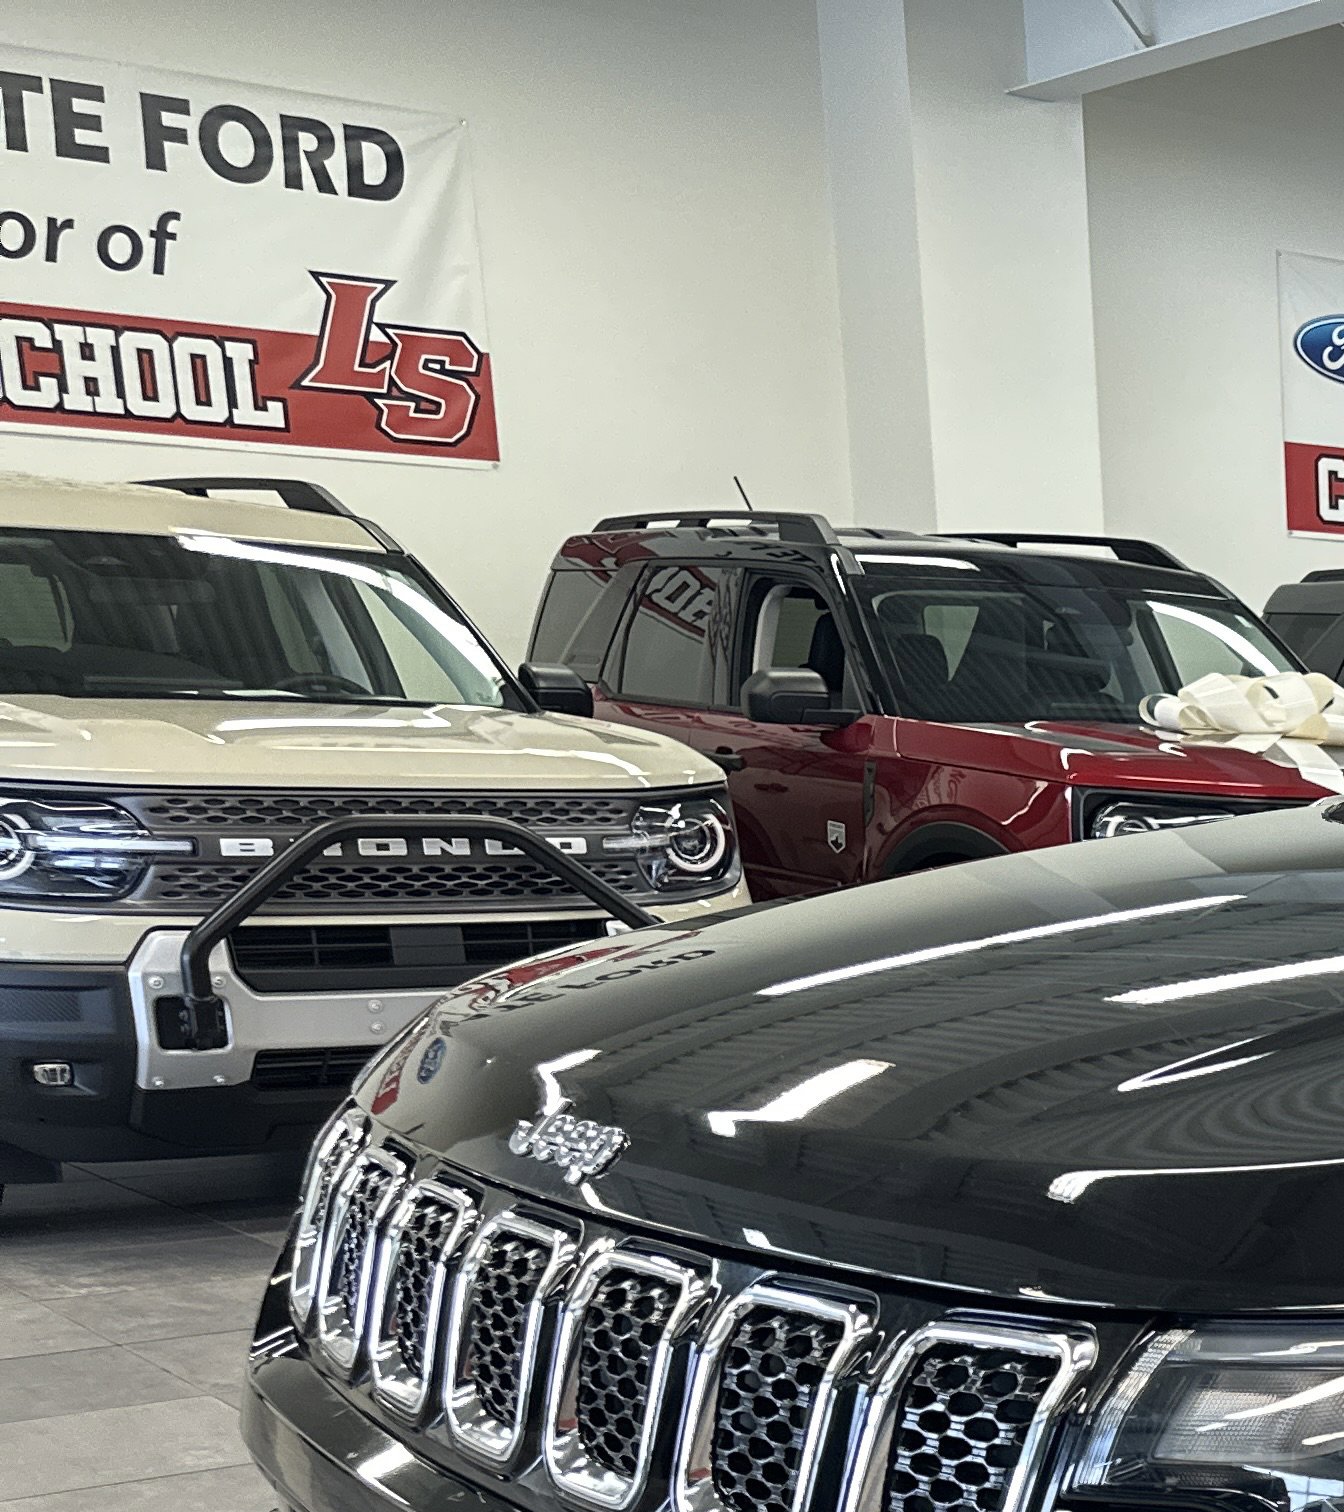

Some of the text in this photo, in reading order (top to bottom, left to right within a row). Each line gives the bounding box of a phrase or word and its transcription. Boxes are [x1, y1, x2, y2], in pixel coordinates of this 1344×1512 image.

[139, 92, 405, 202] FORD
[97, 211, 181, 275] of
[0, 317, 288, 431] CHOOL
[219, 837, 588, 856] BONCO
